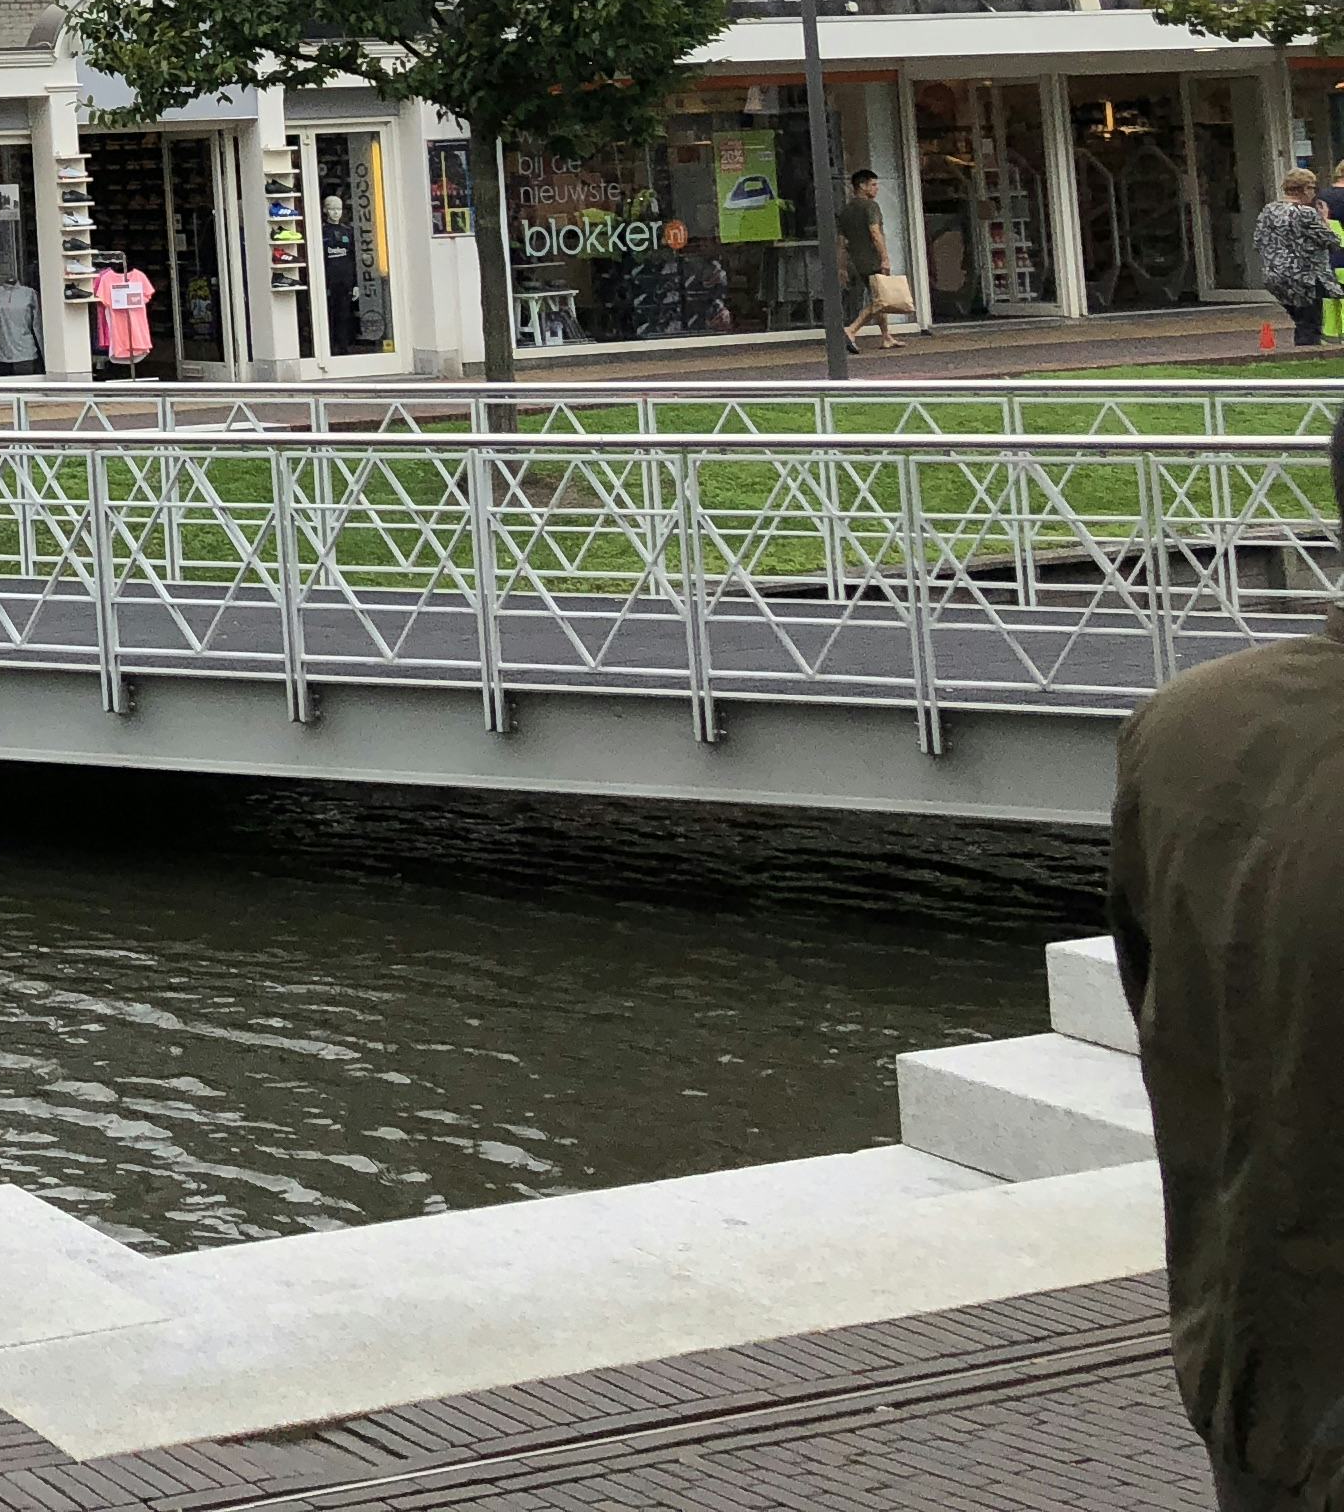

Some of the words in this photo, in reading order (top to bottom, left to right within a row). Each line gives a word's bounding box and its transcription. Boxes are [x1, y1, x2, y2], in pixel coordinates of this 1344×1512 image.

[518, 151, 545, 181] bij
[520, 178, 623, 206] nieuwste
[521, 215, 663, 257] blokker
